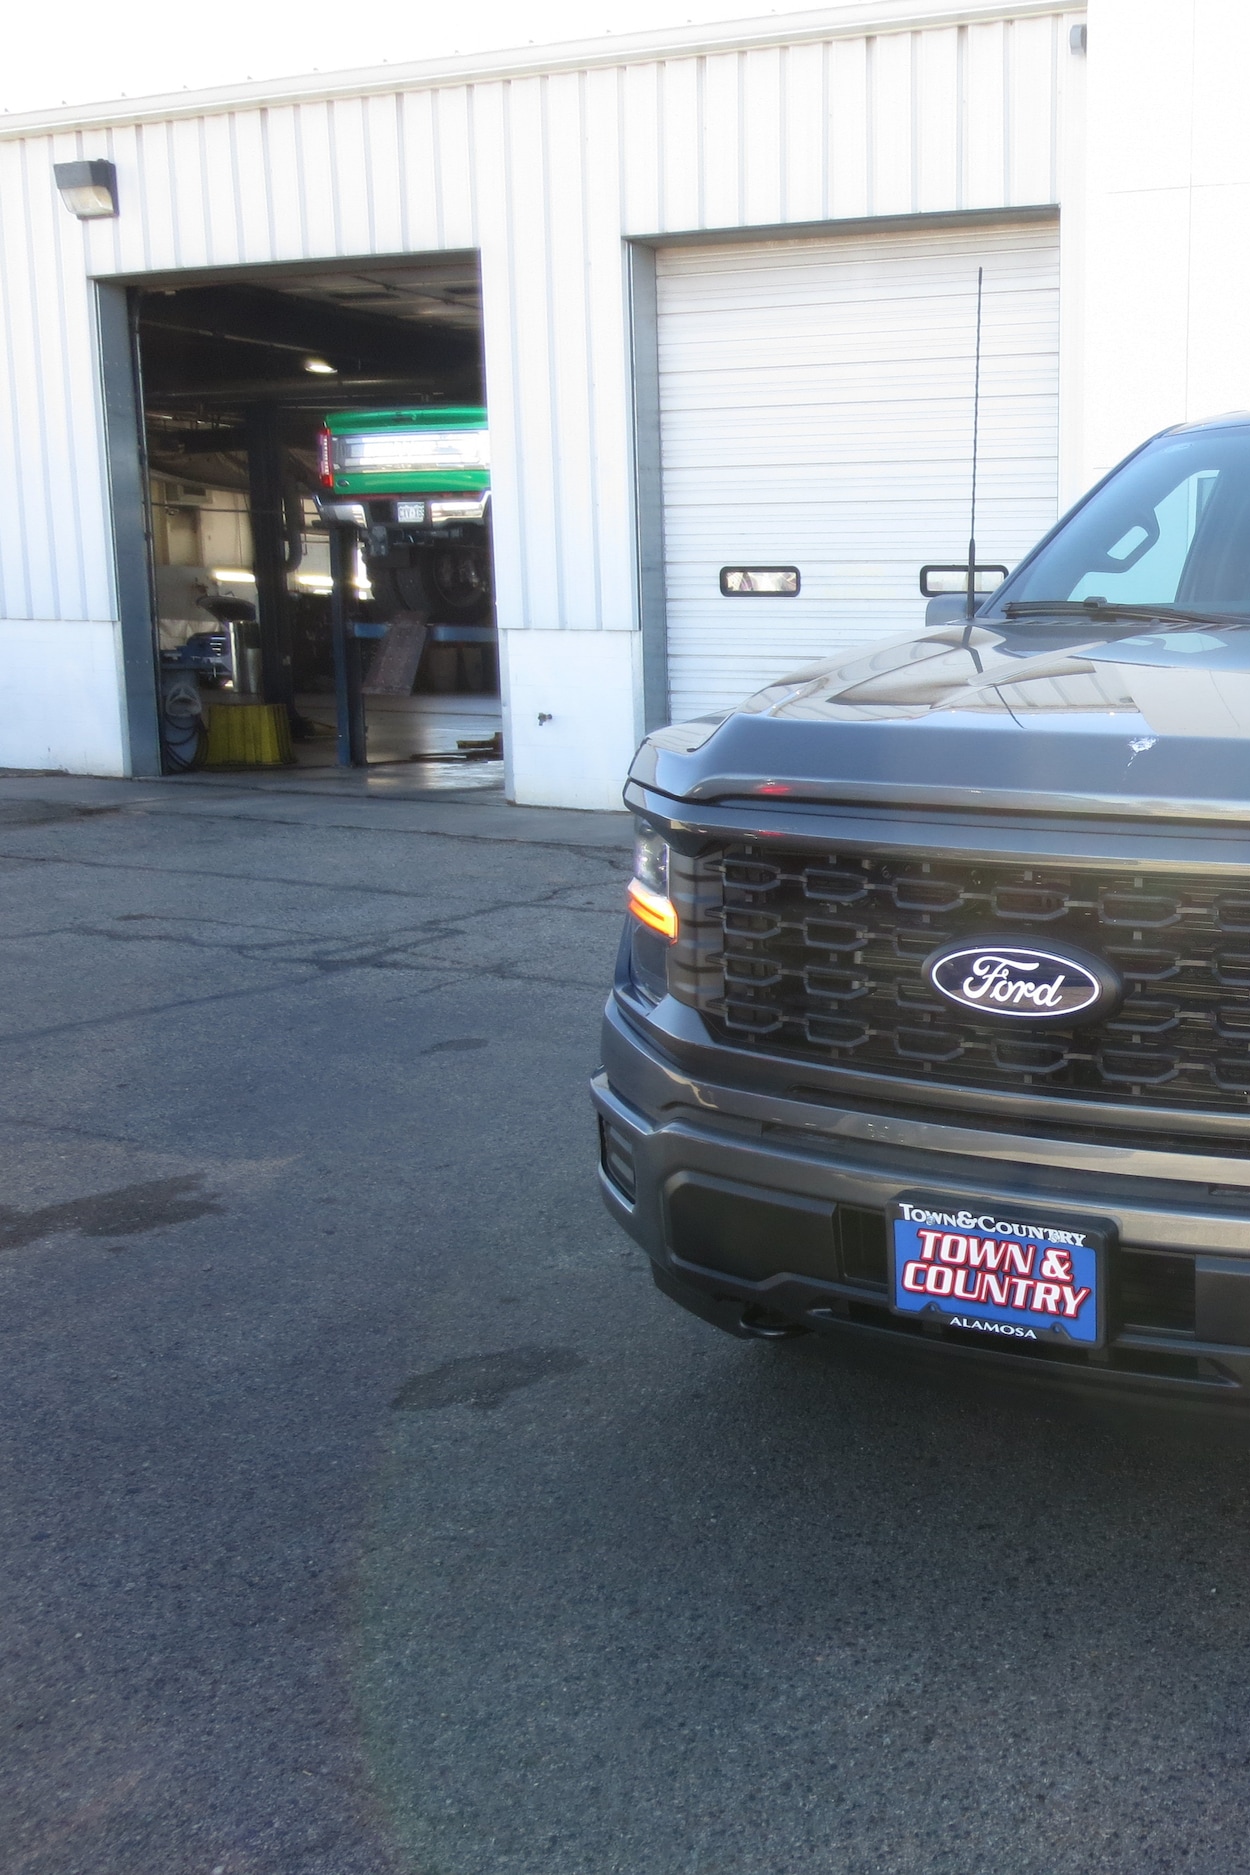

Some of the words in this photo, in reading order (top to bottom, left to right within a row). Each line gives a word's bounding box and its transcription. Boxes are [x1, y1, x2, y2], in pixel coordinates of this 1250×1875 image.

[963, 956, 1066, 1007] Ford
[917, 1228, 1037, 1276] TOWN
[1040, 1247, 1074, 1283] &
[902, 1260, 1092, 1318] COUNTRY
[949, 1316, 1038, 1340] ALAMOSA
